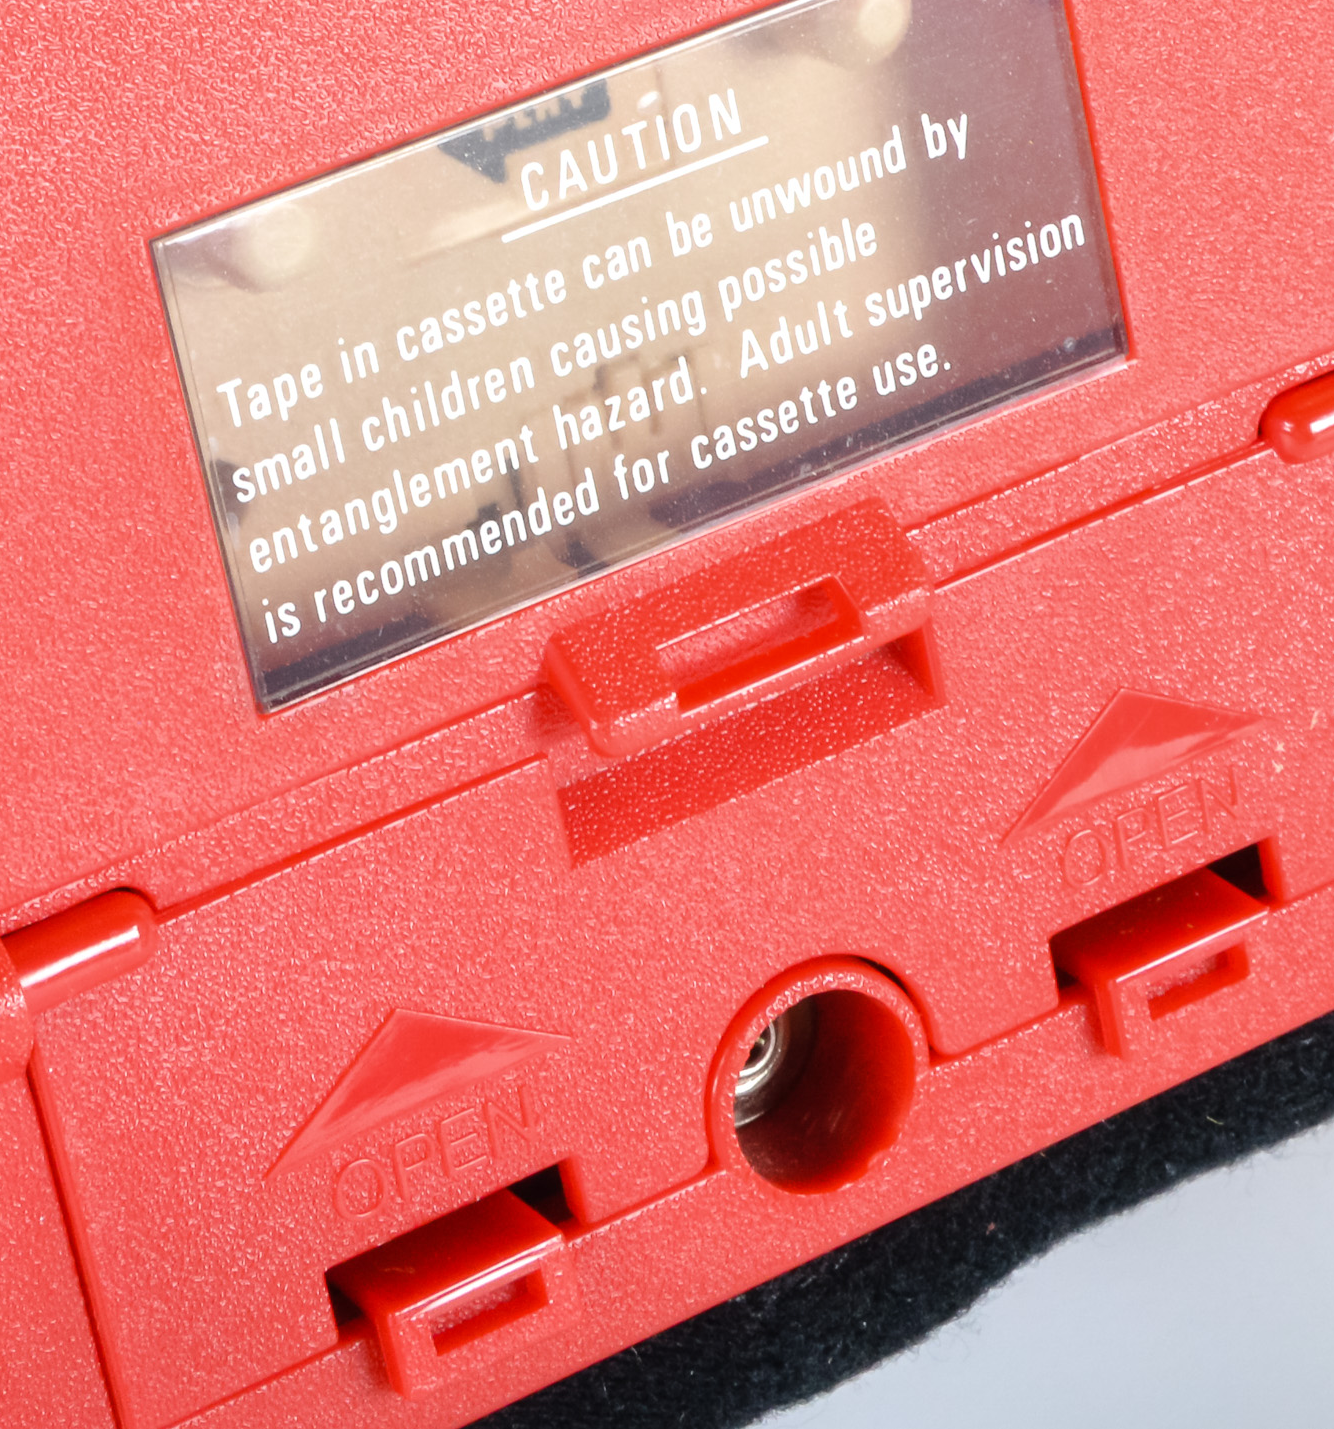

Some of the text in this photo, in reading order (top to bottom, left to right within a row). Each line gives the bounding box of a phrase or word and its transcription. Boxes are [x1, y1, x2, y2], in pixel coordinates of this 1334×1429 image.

[215, 112, 970, 429] Tape in cassette can be unwound by
[520, 89, 742, 212] CAUTION
[232, 218, 879, 503] small children causing possible
[248, 213, 1085, 573] entanglement hazard. Adult supervision
[263, 344, 952, 643] is recommended for cassette use.
[1062, 765, 1241, 890] OPEN
[333, 1085, 541, 1222] OPEN
